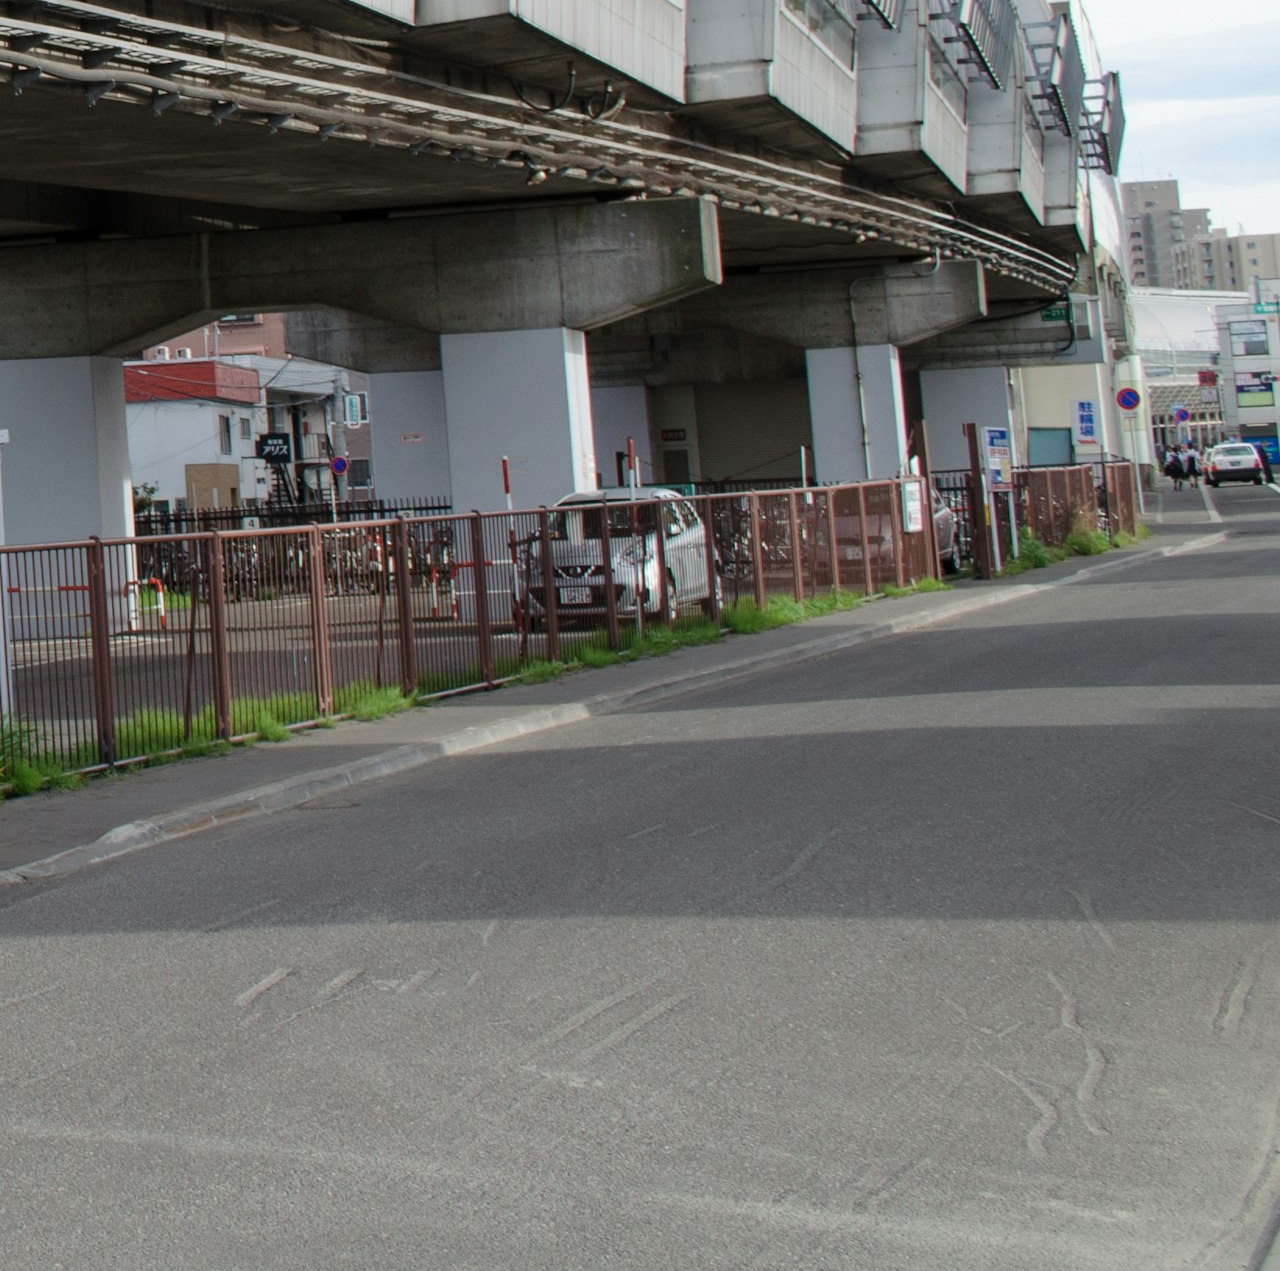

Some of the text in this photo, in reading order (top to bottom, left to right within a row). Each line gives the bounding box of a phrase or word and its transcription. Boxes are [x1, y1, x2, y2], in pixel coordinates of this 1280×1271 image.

[262, 445, 288, 455] アリス
[248, 519, 255, 527] 4
